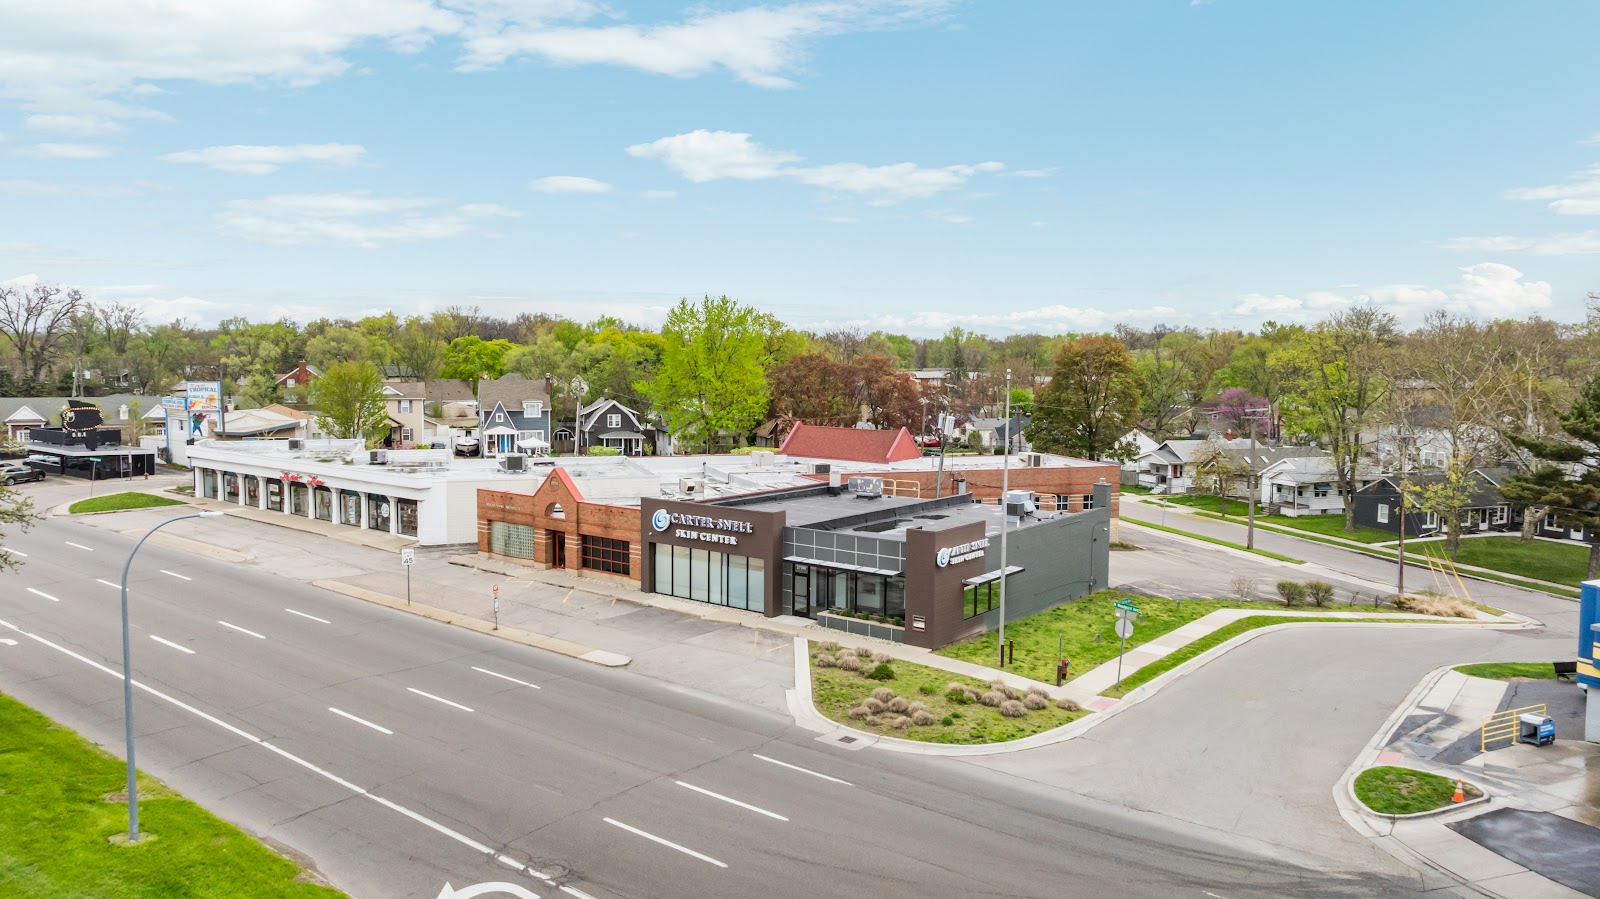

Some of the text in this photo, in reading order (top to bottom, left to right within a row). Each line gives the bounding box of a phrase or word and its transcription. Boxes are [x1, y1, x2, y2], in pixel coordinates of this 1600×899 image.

[670, 512, 754, 534] CARTER SNELL
[675, 529, 738, 545] SKIN CENTER
